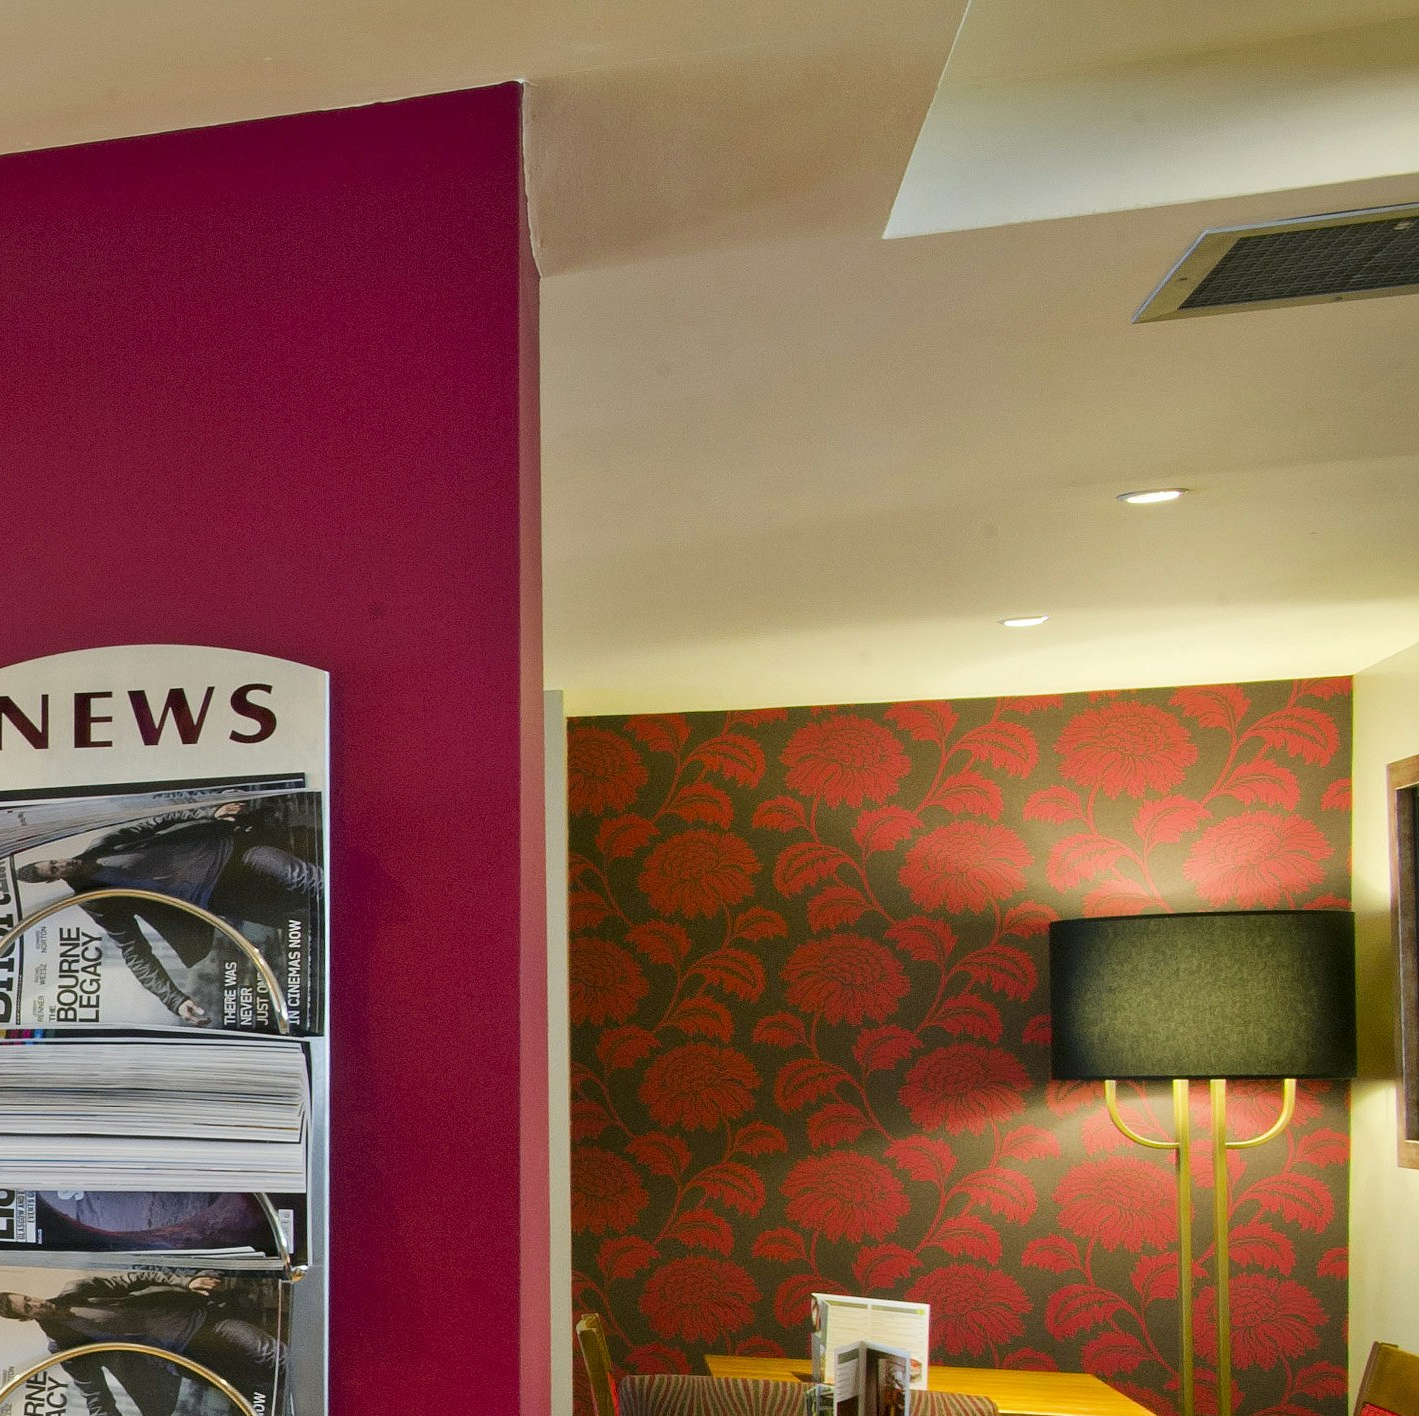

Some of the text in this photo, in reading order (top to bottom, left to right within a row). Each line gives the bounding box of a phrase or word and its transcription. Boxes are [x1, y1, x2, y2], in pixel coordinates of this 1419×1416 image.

[56, 927, 81, 1022] BOURNE
[78, 931, 103, 1023] LEGACY
[224, 962, 237, 1026] THERE WAS
[287, 919, 301, 1025] IN CINEMAS NOW
[49, 1005, 57, 1022] THE
[240, 987, 253, 1026] NEVER
[256, 997, 269, 1026] JUST
